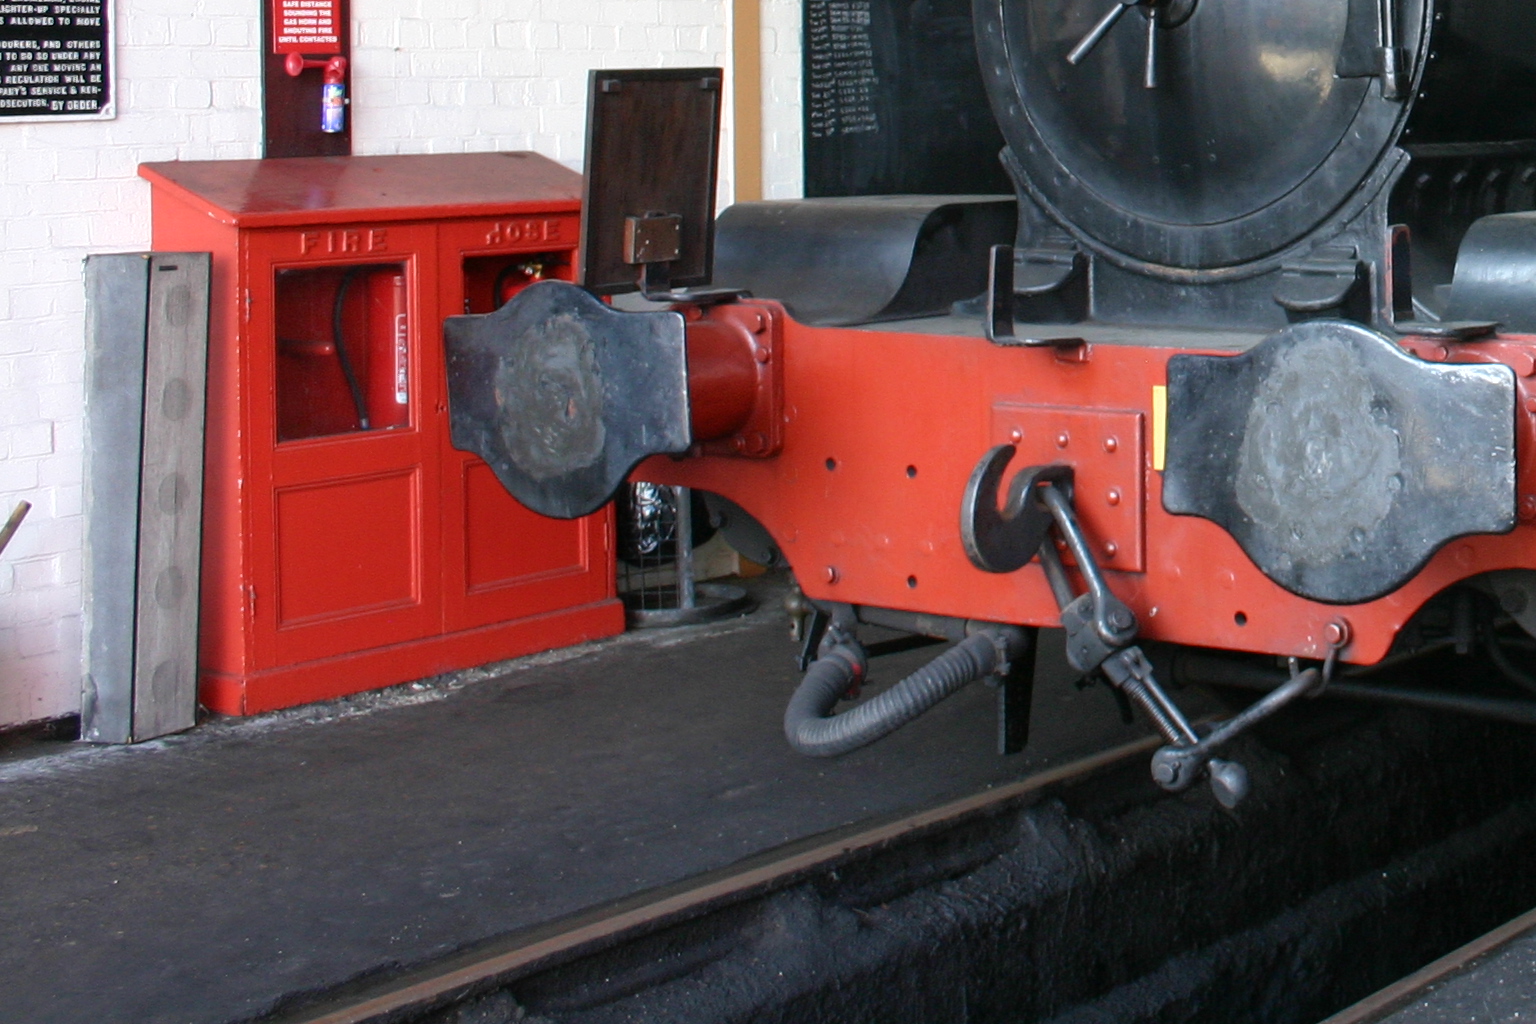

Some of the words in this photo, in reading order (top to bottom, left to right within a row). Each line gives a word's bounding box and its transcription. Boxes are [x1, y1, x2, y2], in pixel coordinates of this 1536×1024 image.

[282, 0, 299, 8] SAFE
[10, 17, 55, 25] ALLOWED
[58, 17, 71, 25] TO
[76, 17, 101, 26] MOVE
[66, 40, 101, 49] OTHERS
[83, 52, 101, 60] ANY
[10, 64, 29, 72] ANY
[53, 63, 87, 72] MOVING
[64, 75, 85, 83] WILL
[300, 228, 388, 254] FIRE
